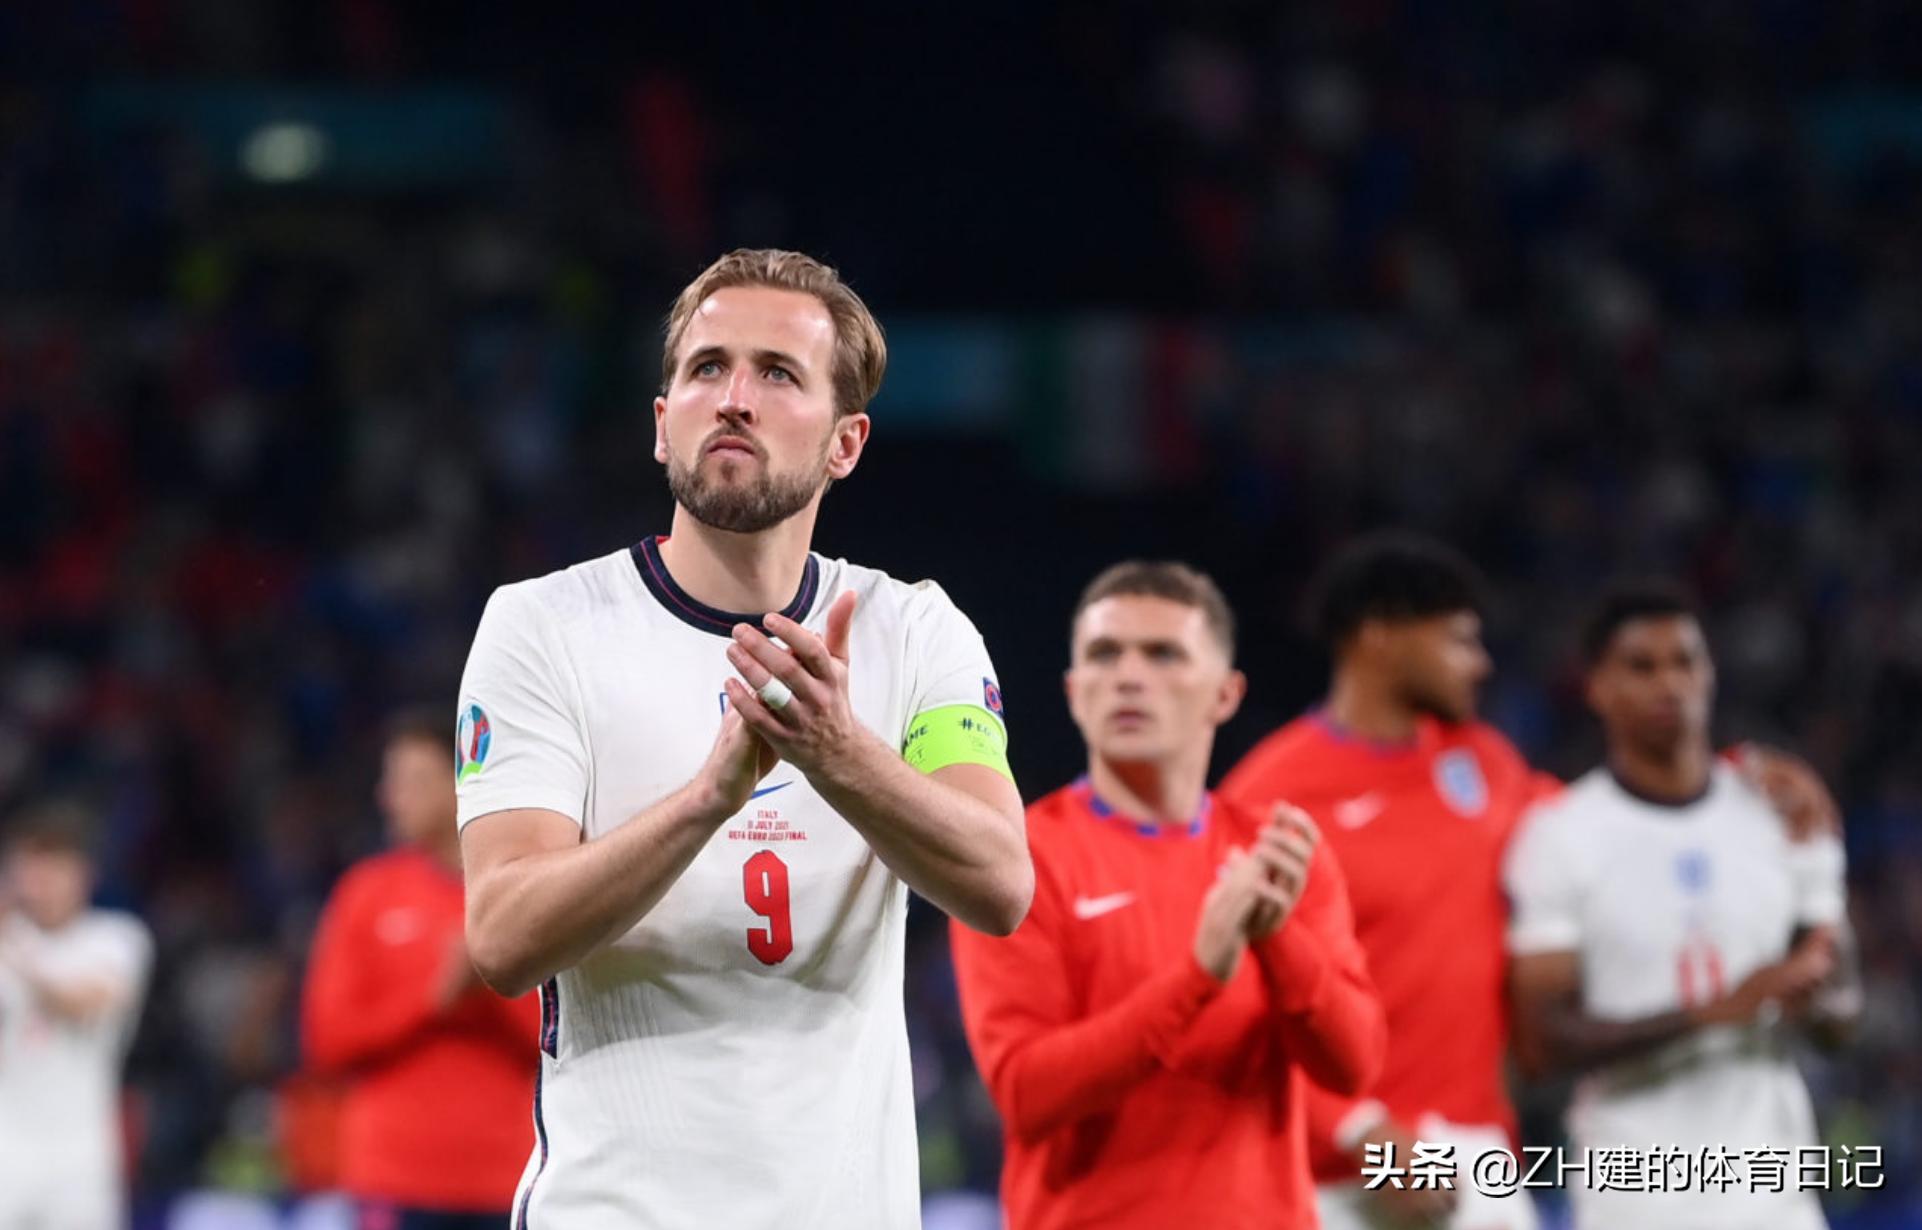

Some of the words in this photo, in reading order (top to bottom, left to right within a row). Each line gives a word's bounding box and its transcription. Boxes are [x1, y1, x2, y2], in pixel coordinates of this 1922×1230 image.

[757, 810, 778, 819] ITALY
[755, 821, 772, 830] JULY
[728, 830, 746, 840] UEFA
[748, 831, 767, 840] EURO
[785, 831, 808, 840] FINAL
[743, 849, 793, 966] 9
